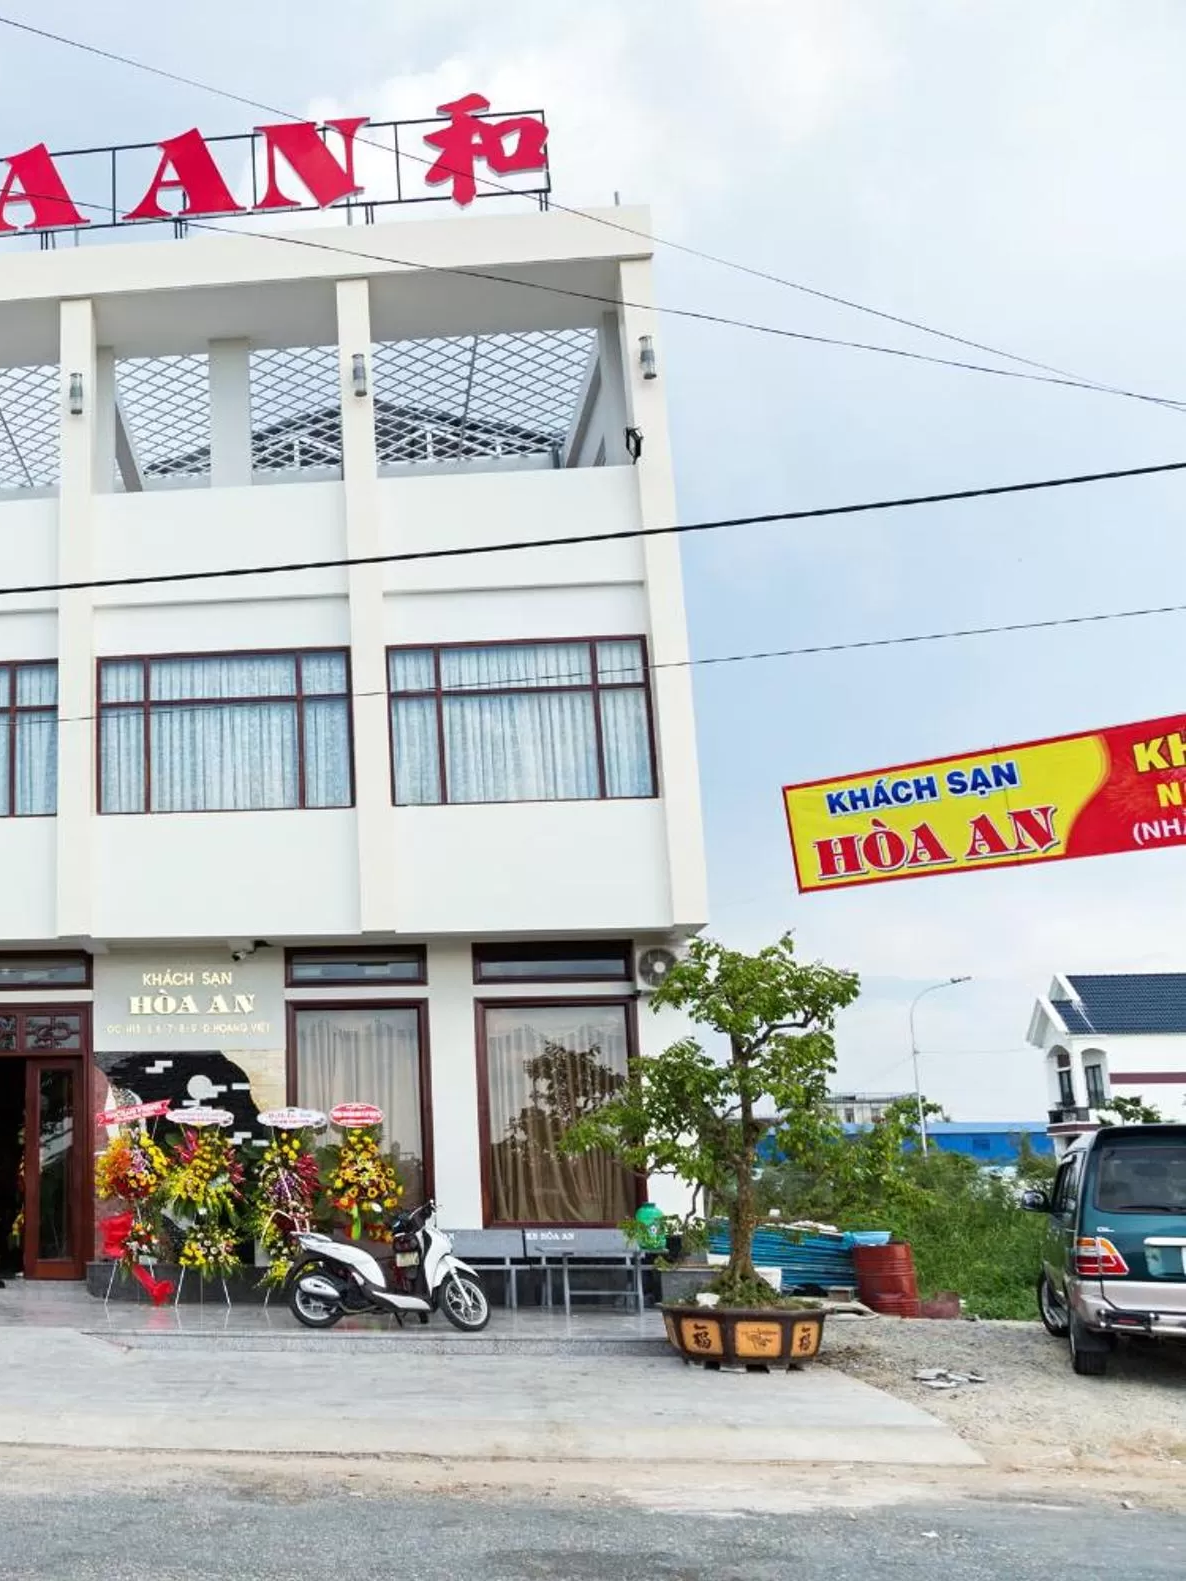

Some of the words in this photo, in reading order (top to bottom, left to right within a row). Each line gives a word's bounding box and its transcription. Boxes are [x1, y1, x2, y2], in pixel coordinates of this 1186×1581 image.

[123, 117, 370, 222] AN
[424, 93, 550, 207] 和
[825, 775, 939, 816] KHÁCH
[946, 761, 1020, 798] SẠN
[813, 818, 955, 881] HÒA
[964, 806, 1057, 858] AN
[129, 988, 200, 1015] HÒA
[205, 993, 255, 1015] AN
[142, 968, 194, 986] KHÁCH
